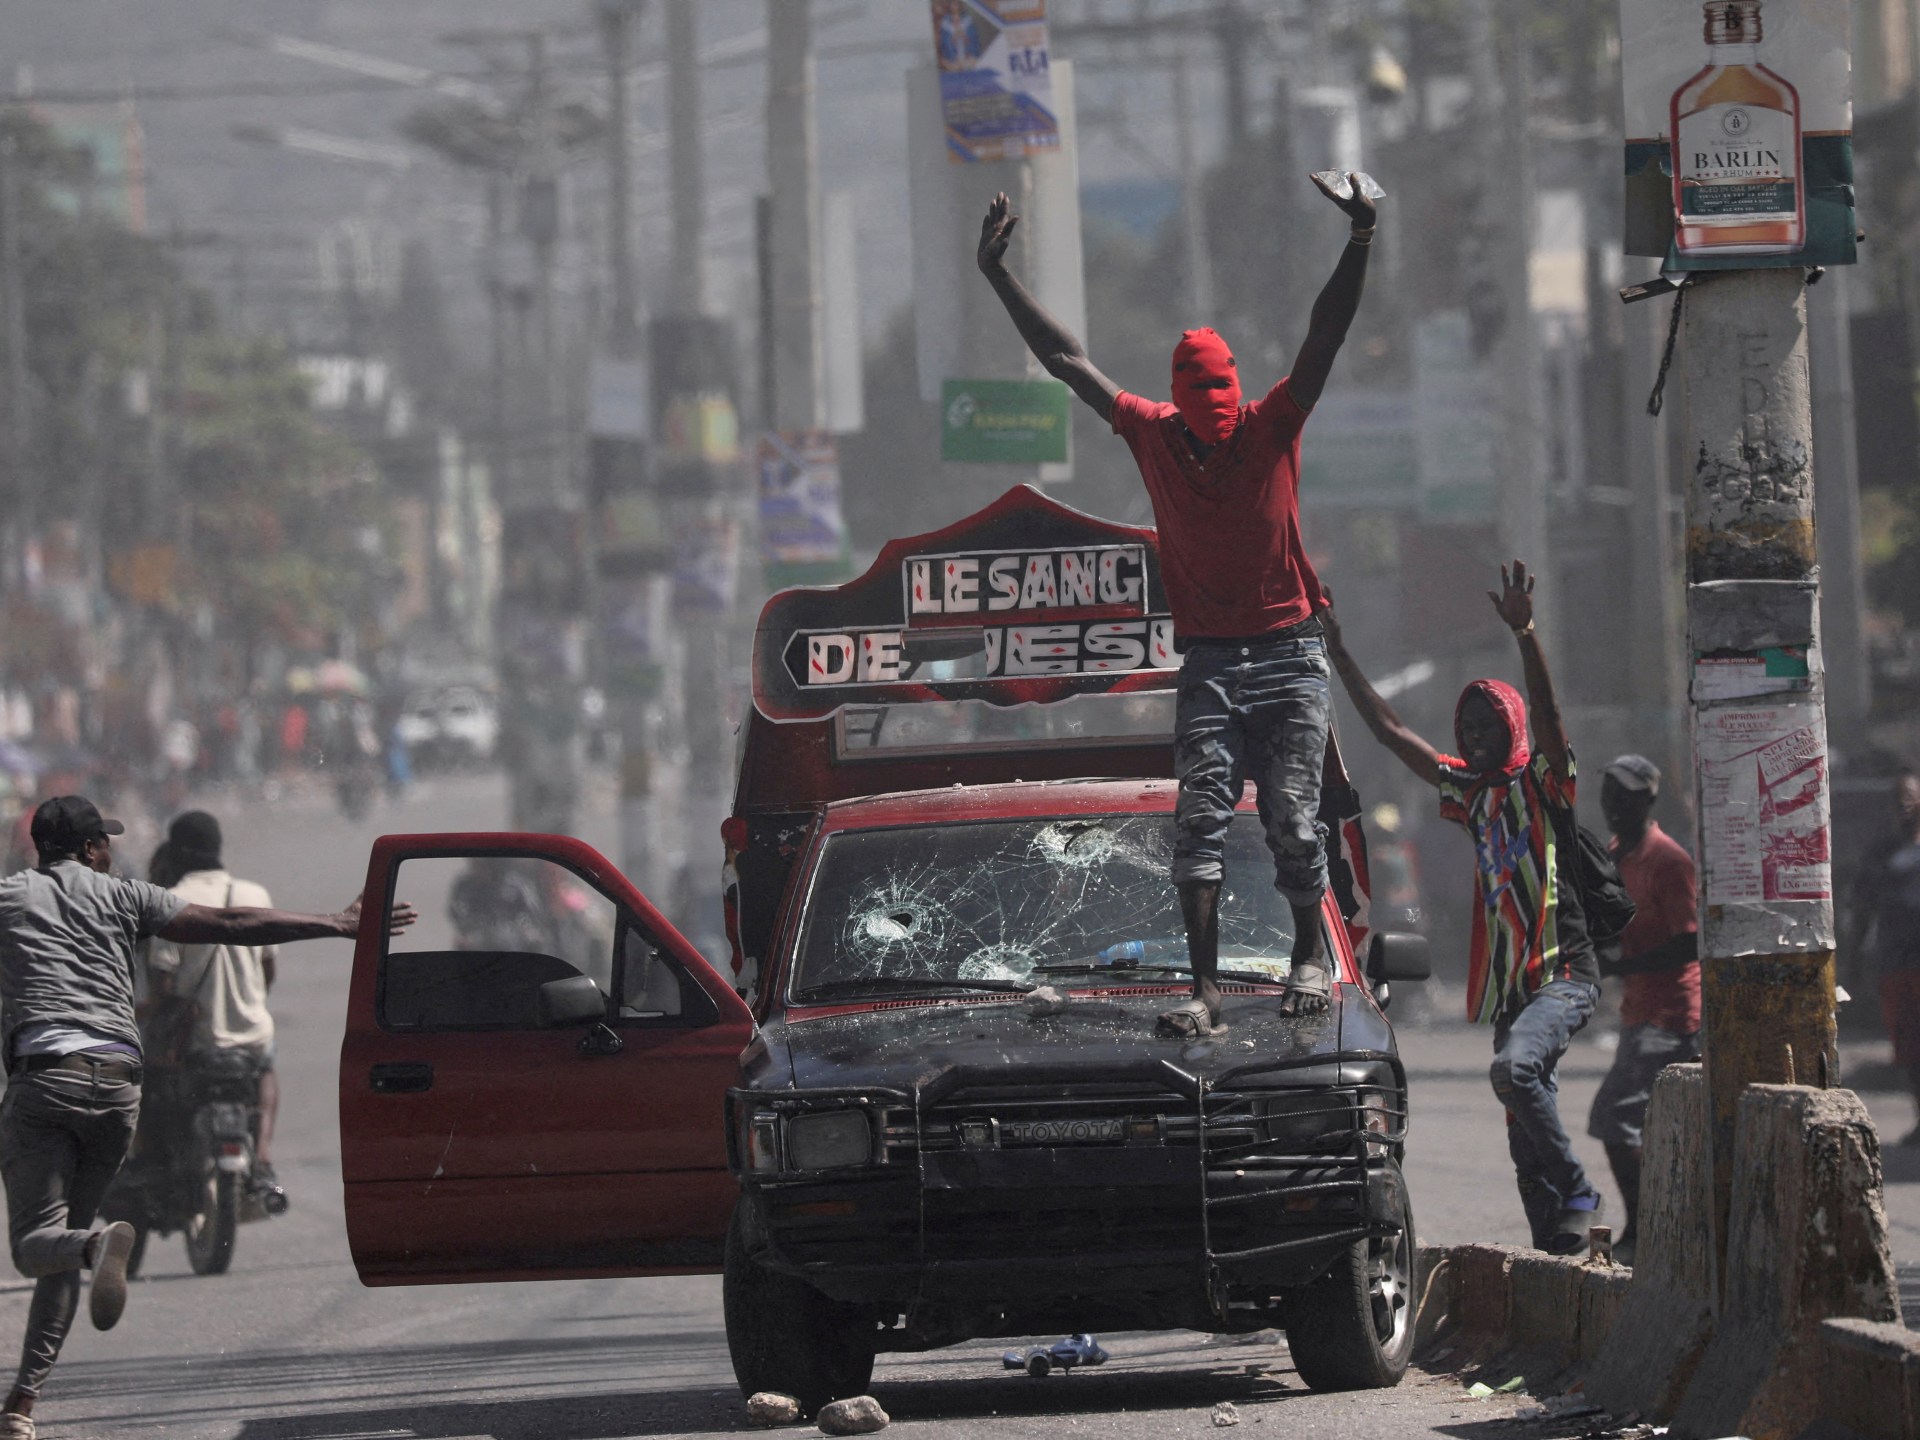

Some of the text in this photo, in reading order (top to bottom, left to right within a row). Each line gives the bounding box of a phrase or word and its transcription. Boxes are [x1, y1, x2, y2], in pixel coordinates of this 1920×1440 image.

[1694, 150, 1780, 169] BARLIN
[808, 632, 900, 684] DE
[1014, 1120, 1124, 1142] TOYOTA
